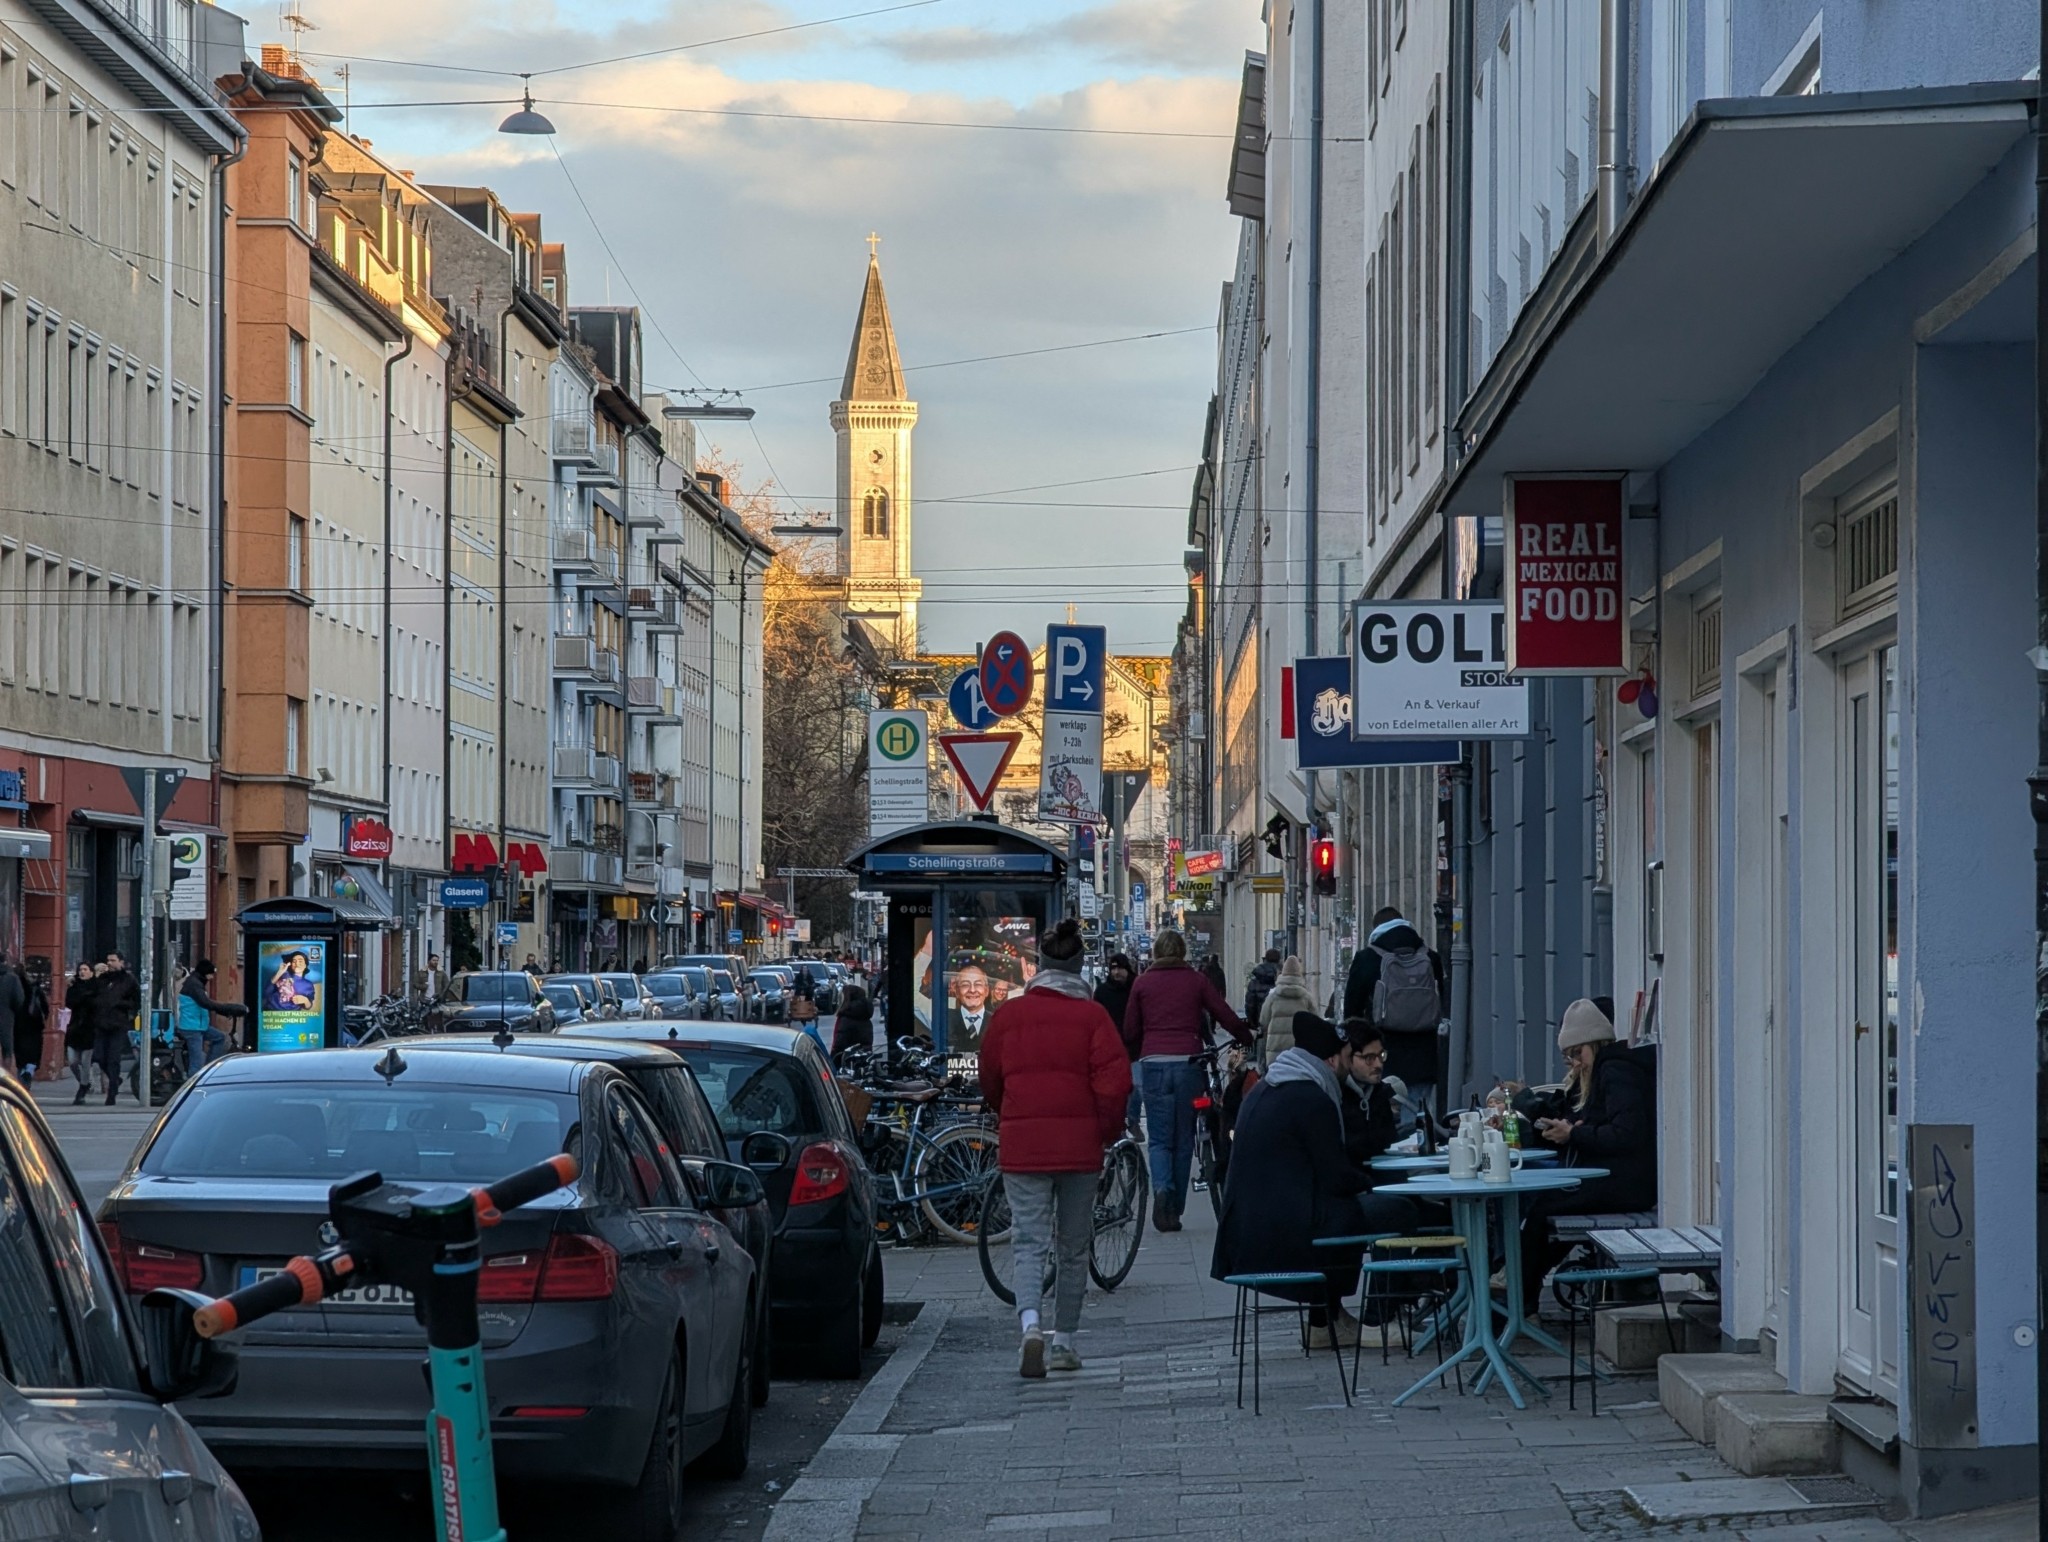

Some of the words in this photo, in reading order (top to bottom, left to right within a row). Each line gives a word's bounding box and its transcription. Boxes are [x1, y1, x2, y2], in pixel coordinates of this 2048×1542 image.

[1520, 523, 1616, 556] REAL
[1520, 562, 1616, 582] MEXICAN
[1520, 587, 1616, 622] FOOD
[1054, 636, 1087, 700] P
[1404, 699, 1421, 710] An
[1424, 699, 1434, 710] &
[1437, 699, 1481, 710] Verkauf
[1059, 721, 1087, 732] werktags
[1367, 721, 1390, 730] von
[1393, 719, 1469, 730] Edelmetallen
[1472, 719, 1497, 729] aller
[1500, 719, 1519, 729] Art
[889, 727, 907, 751] H
[1063, 736, 1082, 748] 9-23h
[1049, 754, 1060, 764] mit
[1062, 754, 1095, 765] Parkschein
[873, 777, 924, 787] Schellingstraße
[908, 856, 1006, 870] Schellingstraße
[445, 887, 484, 896] Glaserei
[1176, 881, 1213, 891] Nikon
[1134, 886, 1142, 900] P
